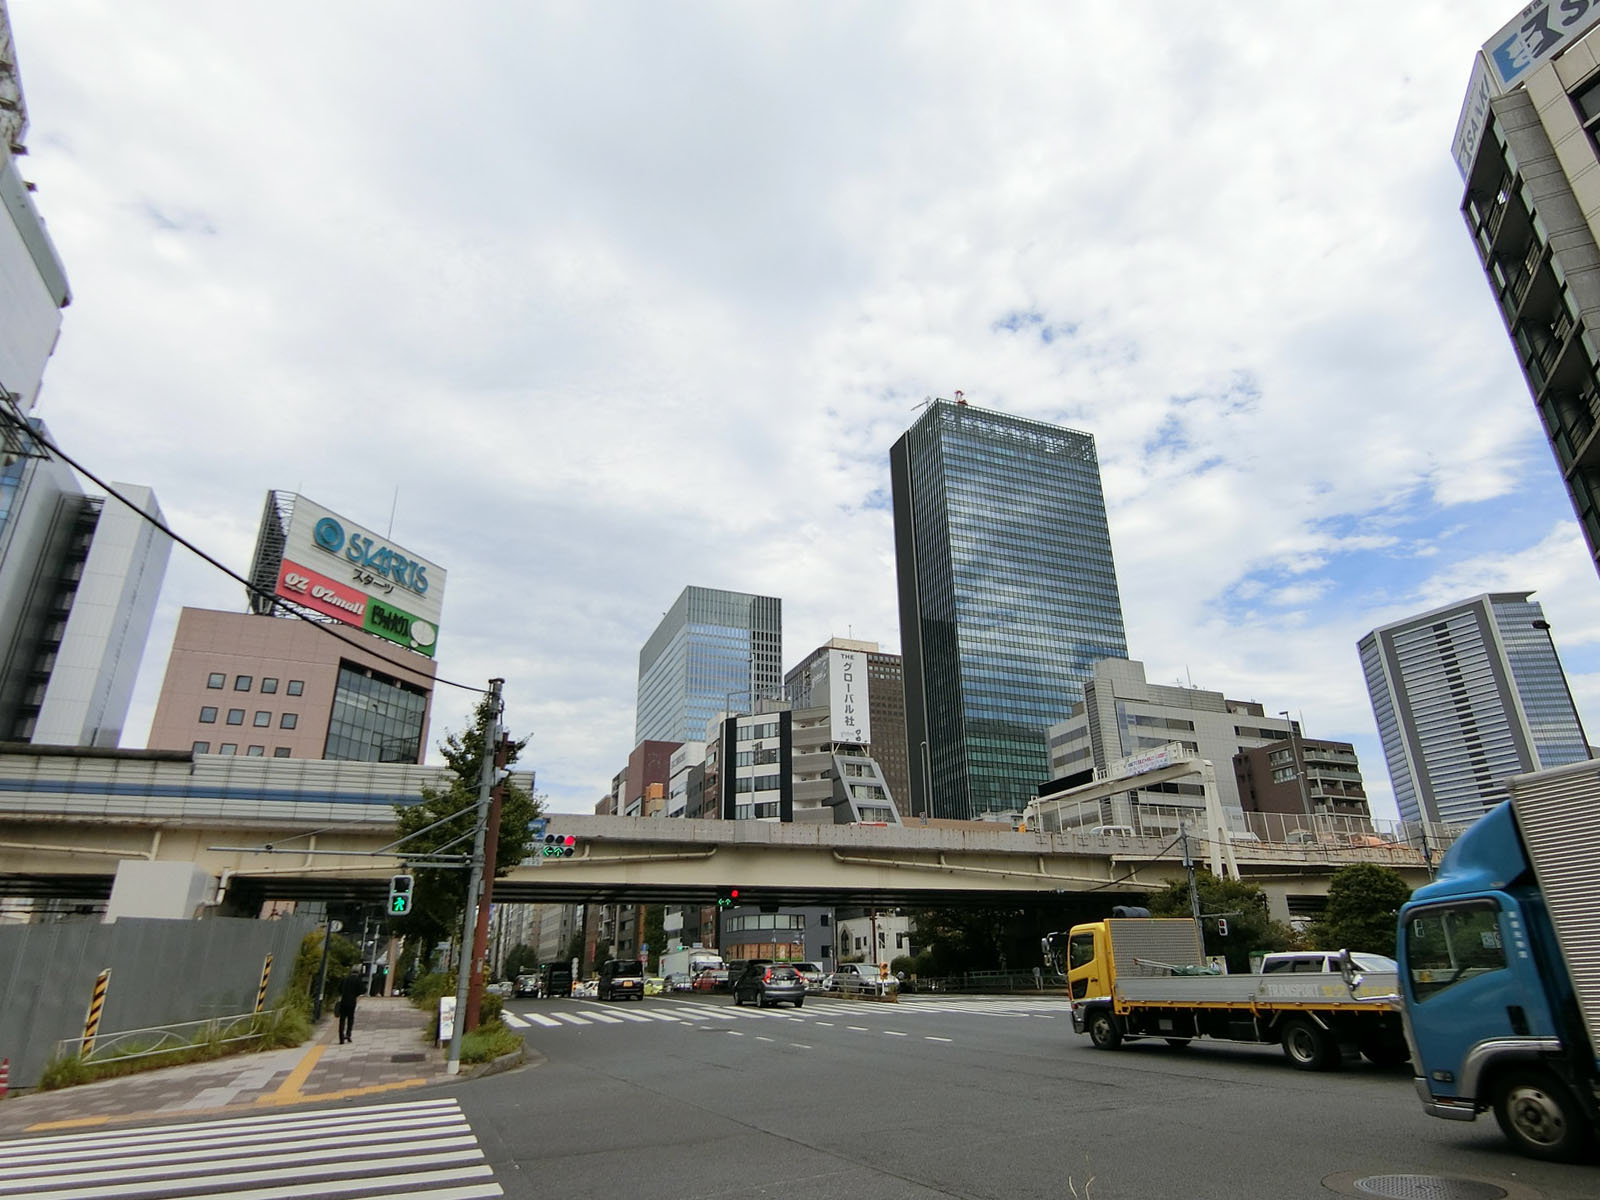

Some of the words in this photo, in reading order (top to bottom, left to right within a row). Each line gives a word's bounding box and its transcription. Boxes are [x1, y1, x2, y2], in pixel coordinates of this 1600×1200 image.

[346, 532, 428, 593] STARTS
[353, 568, 396, 594] スターツ
[283, 572, 309, 592] OZ
[311, 585, 365, 616] OZmall
[843, 662, 855, 726] グローバル社
